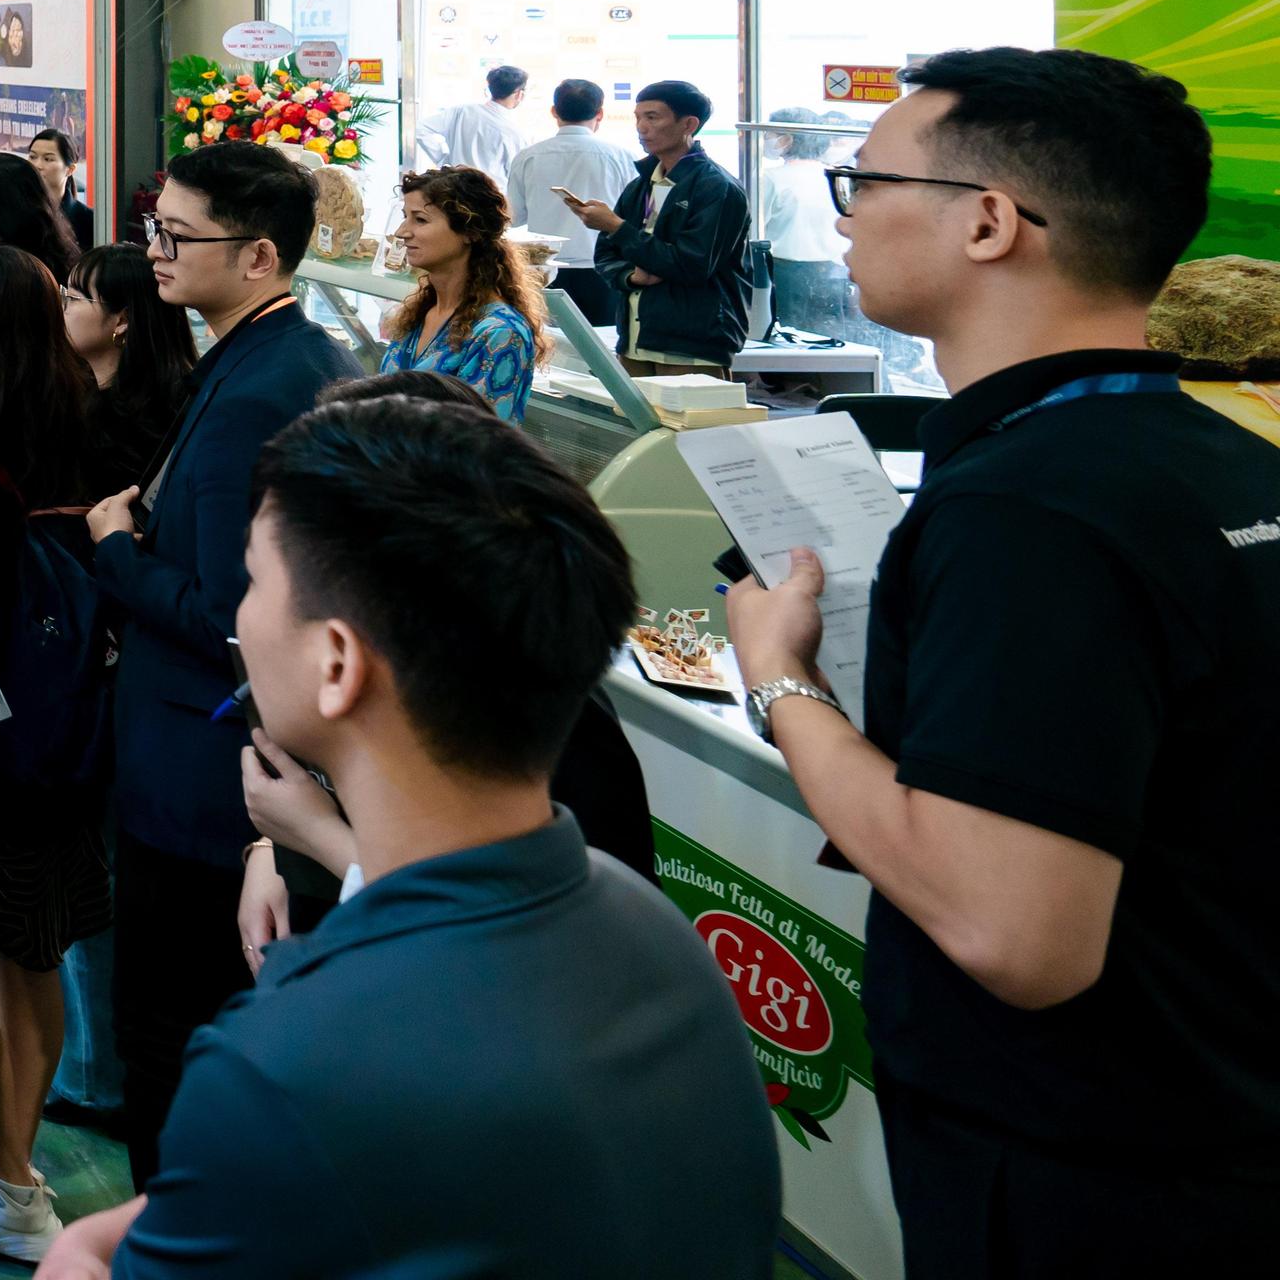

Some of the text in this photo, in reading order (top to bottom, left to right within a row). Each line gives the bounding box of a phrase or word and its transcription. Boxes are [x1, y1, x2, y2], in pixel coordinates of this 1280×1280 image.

[708, 928, 812, 1033] Gigi
[729, 882, 774, 927] Fetta
[778, 919, 799, 945] di
[805, 934, 862, 1000] Mode
